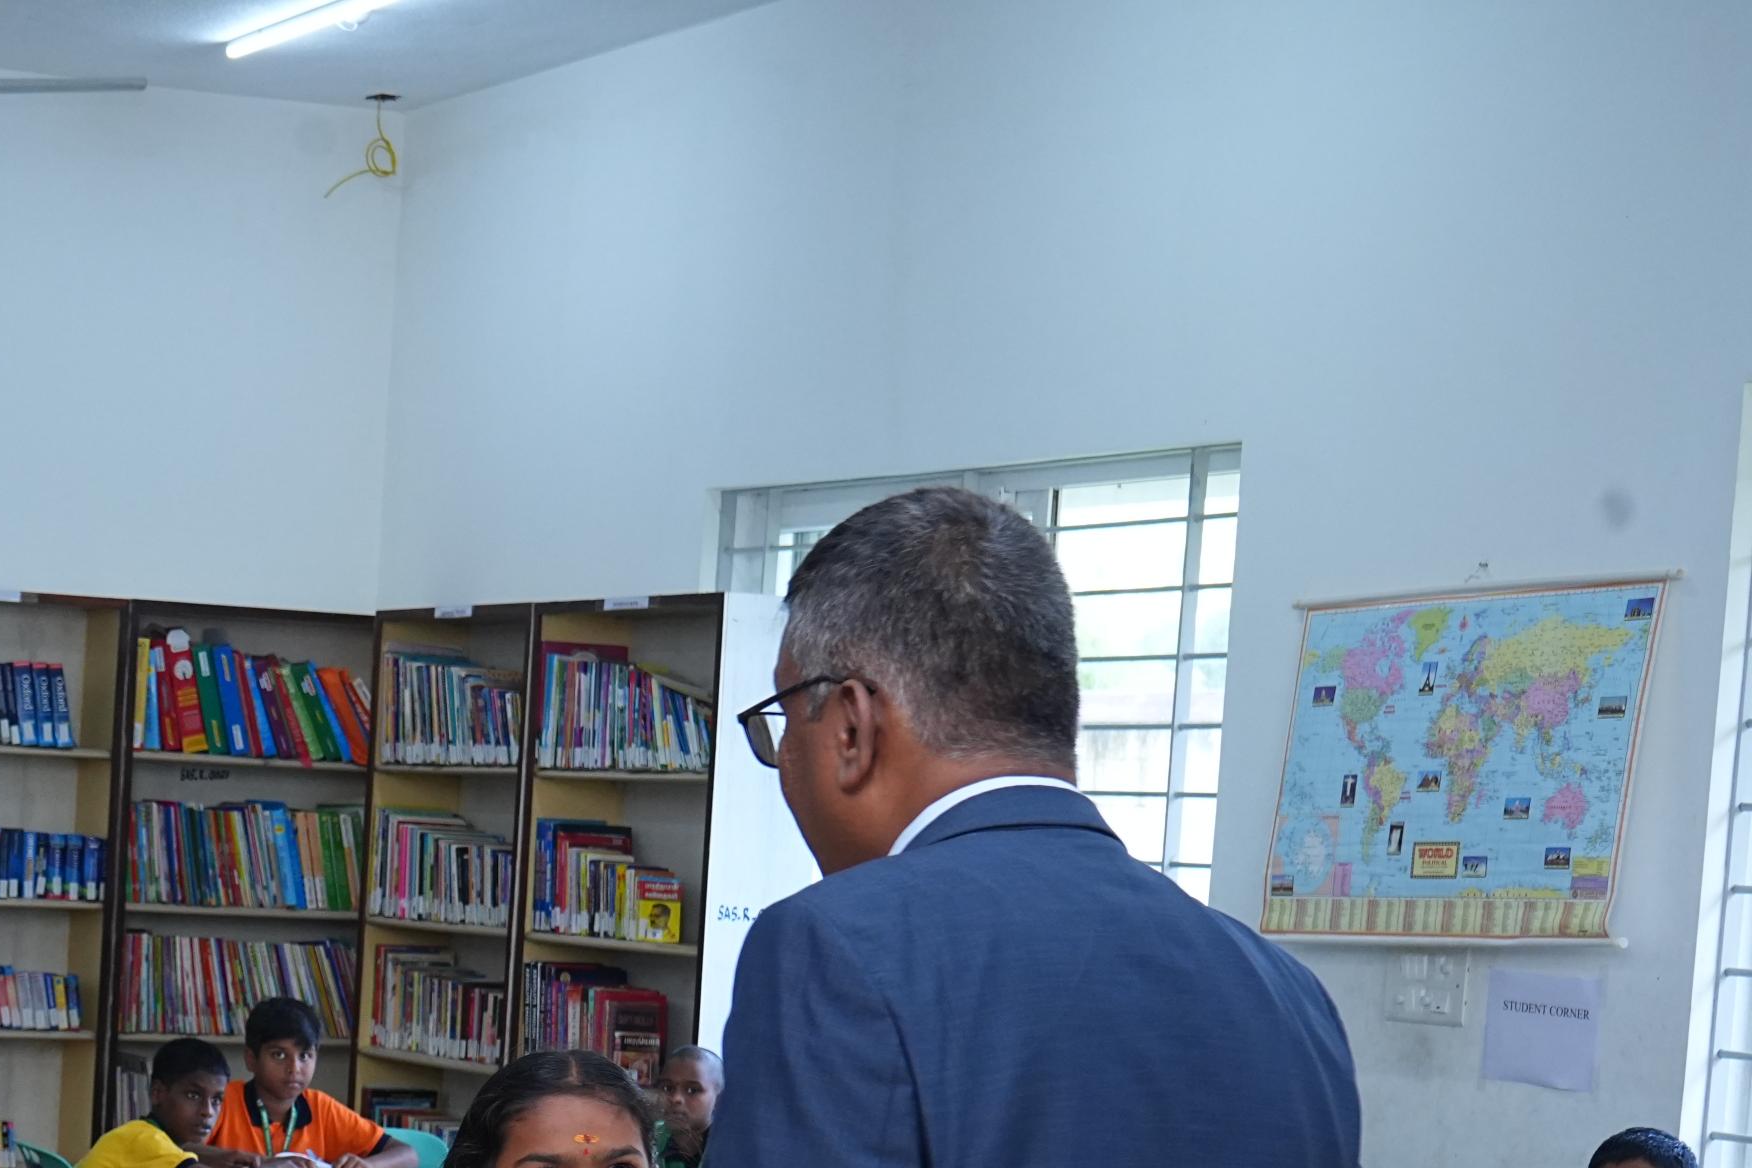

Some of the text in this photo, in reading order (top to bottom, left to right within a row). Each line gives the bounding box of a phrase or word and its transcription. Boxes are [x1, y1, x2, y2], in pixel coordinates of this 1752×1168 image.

[22, 674, 33, 710] Oxford
[40, 676, 51, 712] Oxford
[56, 676, 68, 712] Oxford
[1418, 847, 1454, 859] WORLD
[1503, 1000, 1590, 1020] STUDENT CORNER
